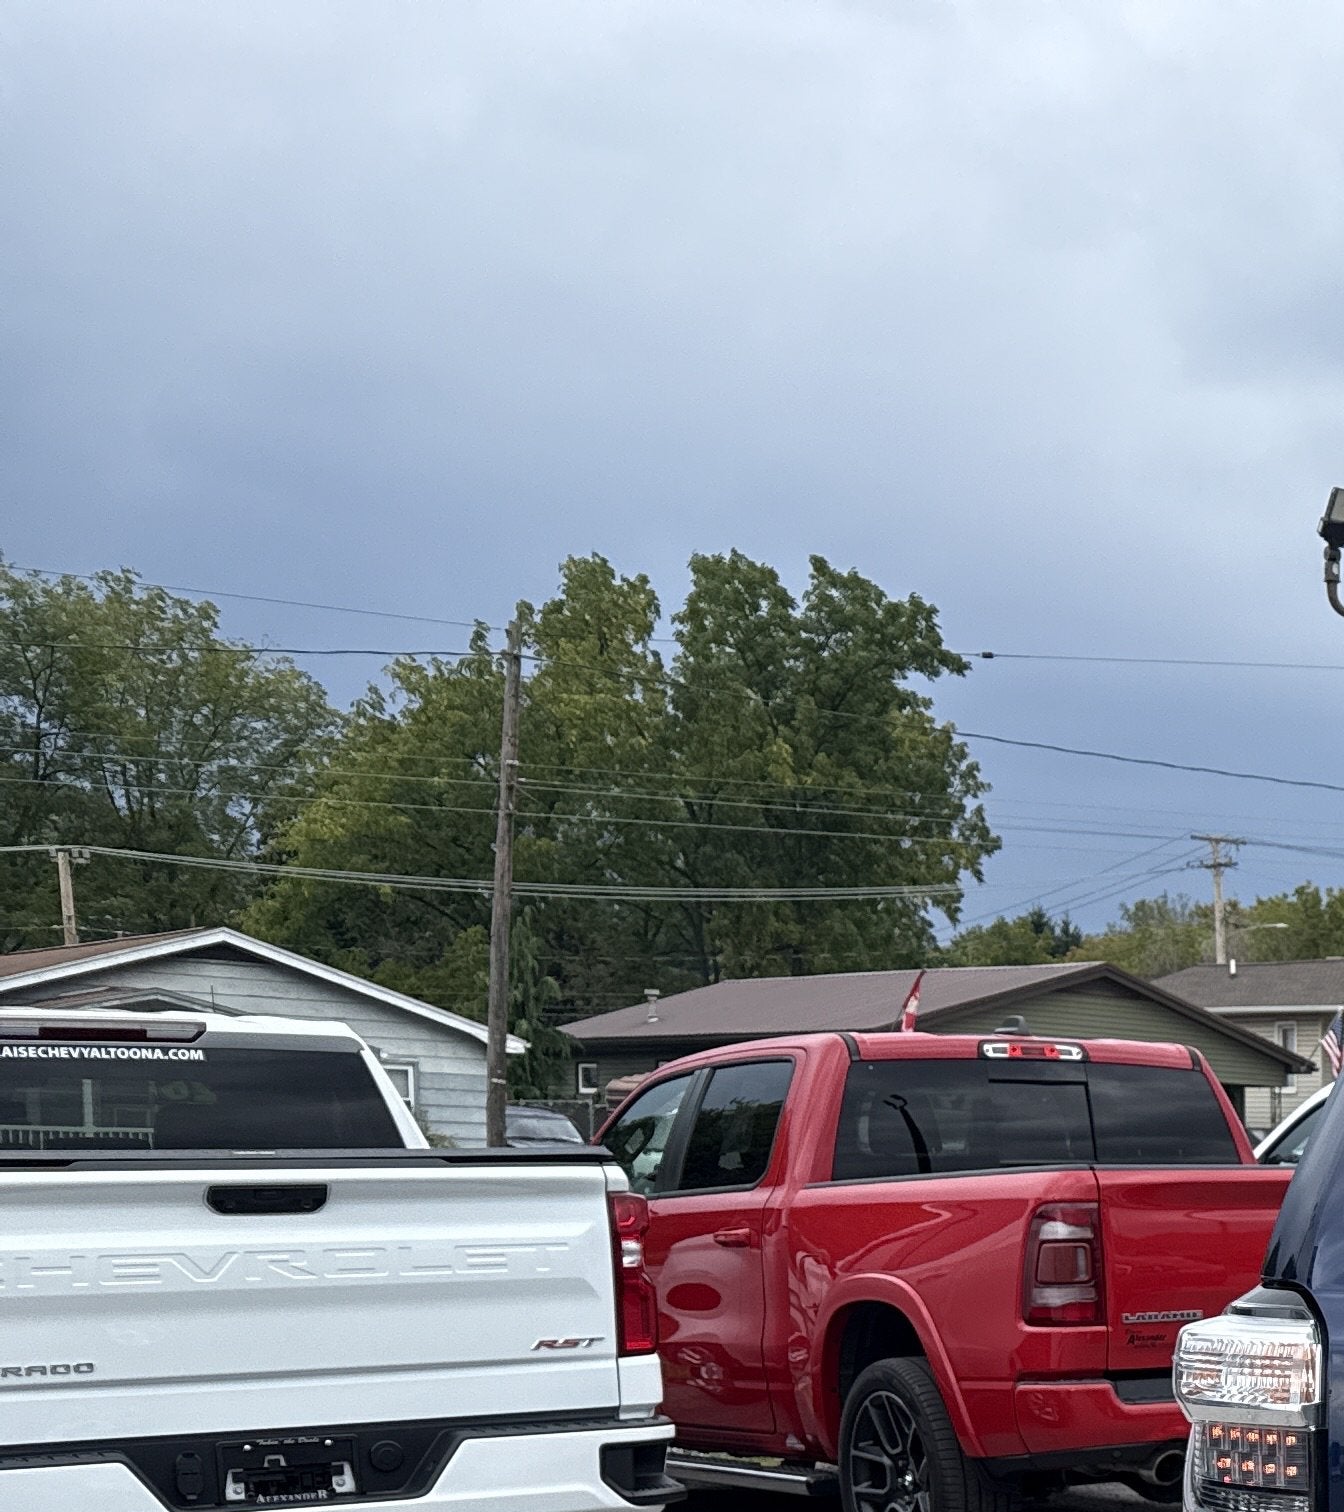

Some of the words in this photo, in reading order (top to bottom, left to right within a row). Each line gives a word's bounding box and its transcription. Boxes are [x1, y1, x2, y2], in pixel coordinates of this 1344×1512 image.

[0, 1046, 205, 1061] AISECHEVYALTOONA.COM
[0, 1243, 569, 1289] HEVROLET
[530, 1337, 605, 1351] RST
